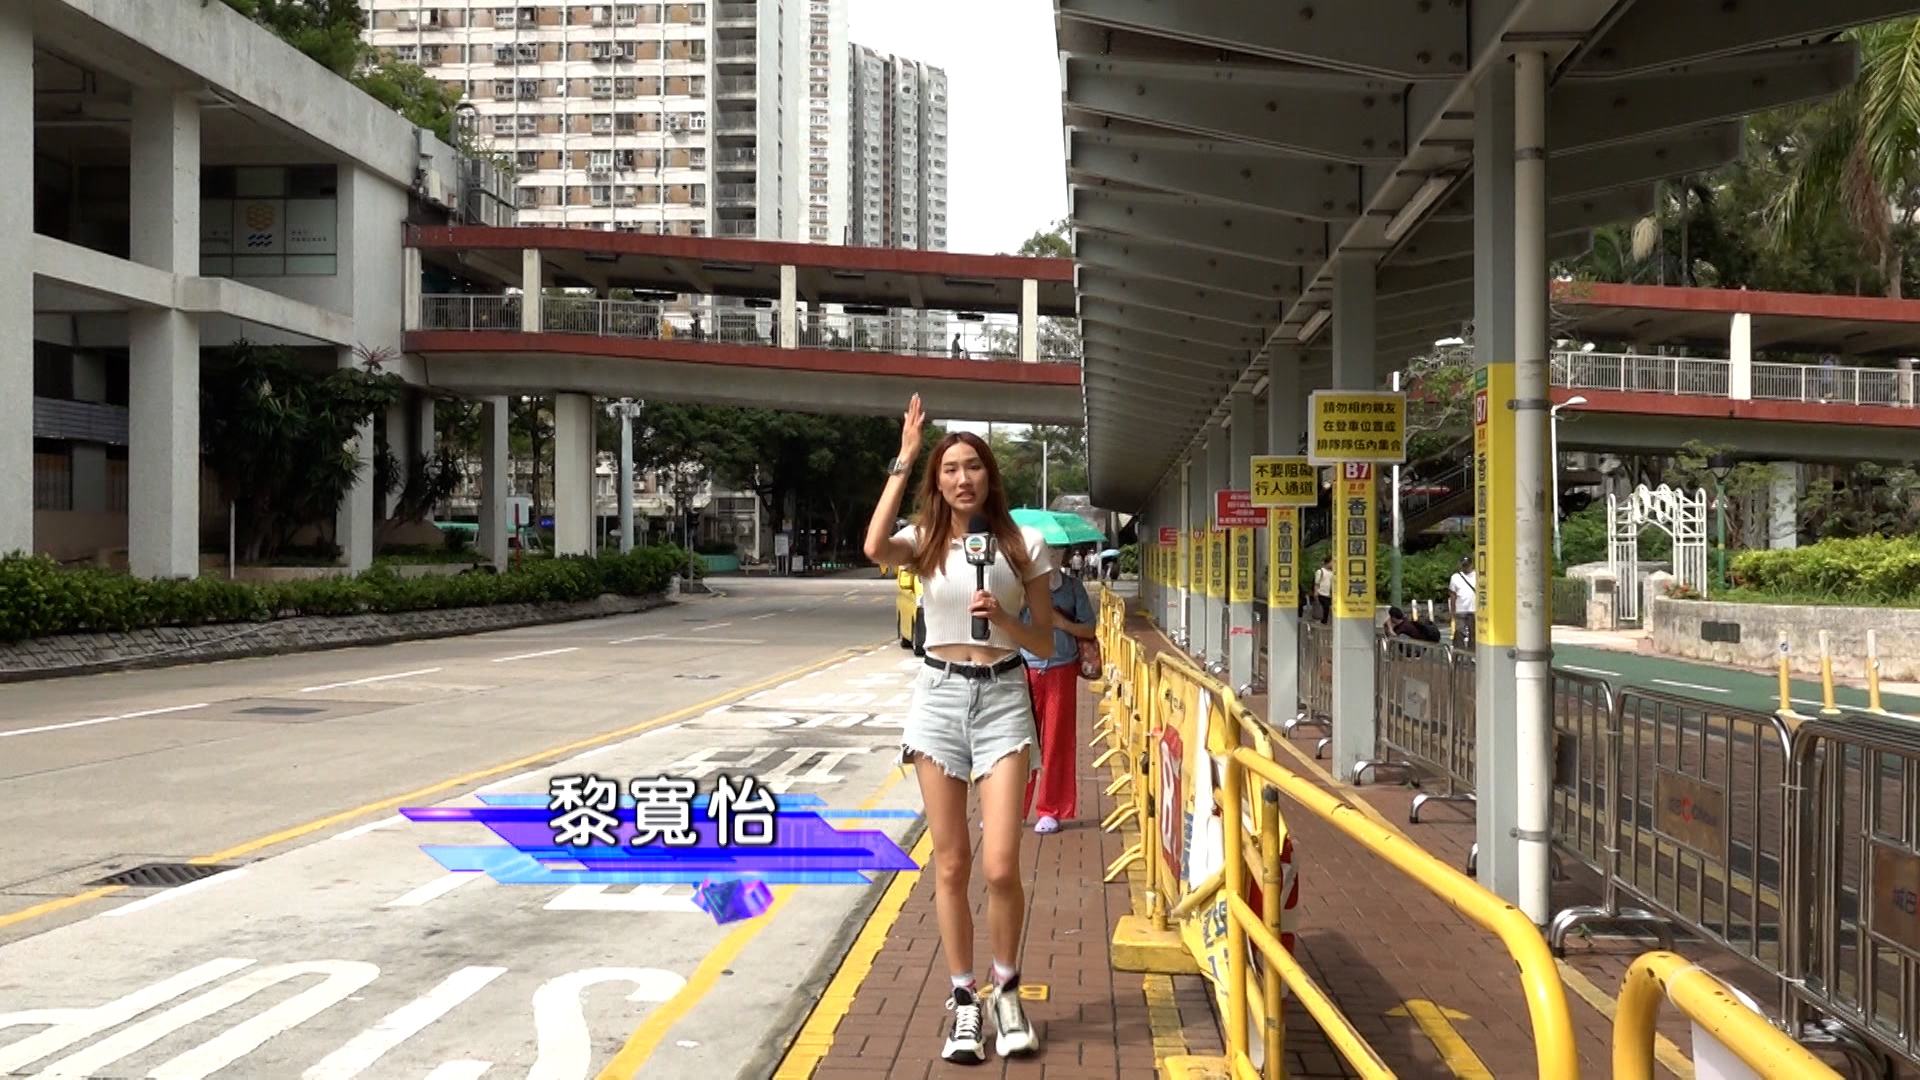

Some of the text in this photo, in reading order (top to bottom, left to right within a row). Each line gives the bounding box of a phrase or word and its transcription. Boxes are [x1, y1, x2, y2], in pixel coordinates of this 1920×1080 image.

[1255, 463, 1313, 479] 不要阻礙
[1345, 463, 1370, 480] B7
[1255, 481, 1314, 496] 行人通道
[1347, 497, 1367, 598] 香園圍口岸
